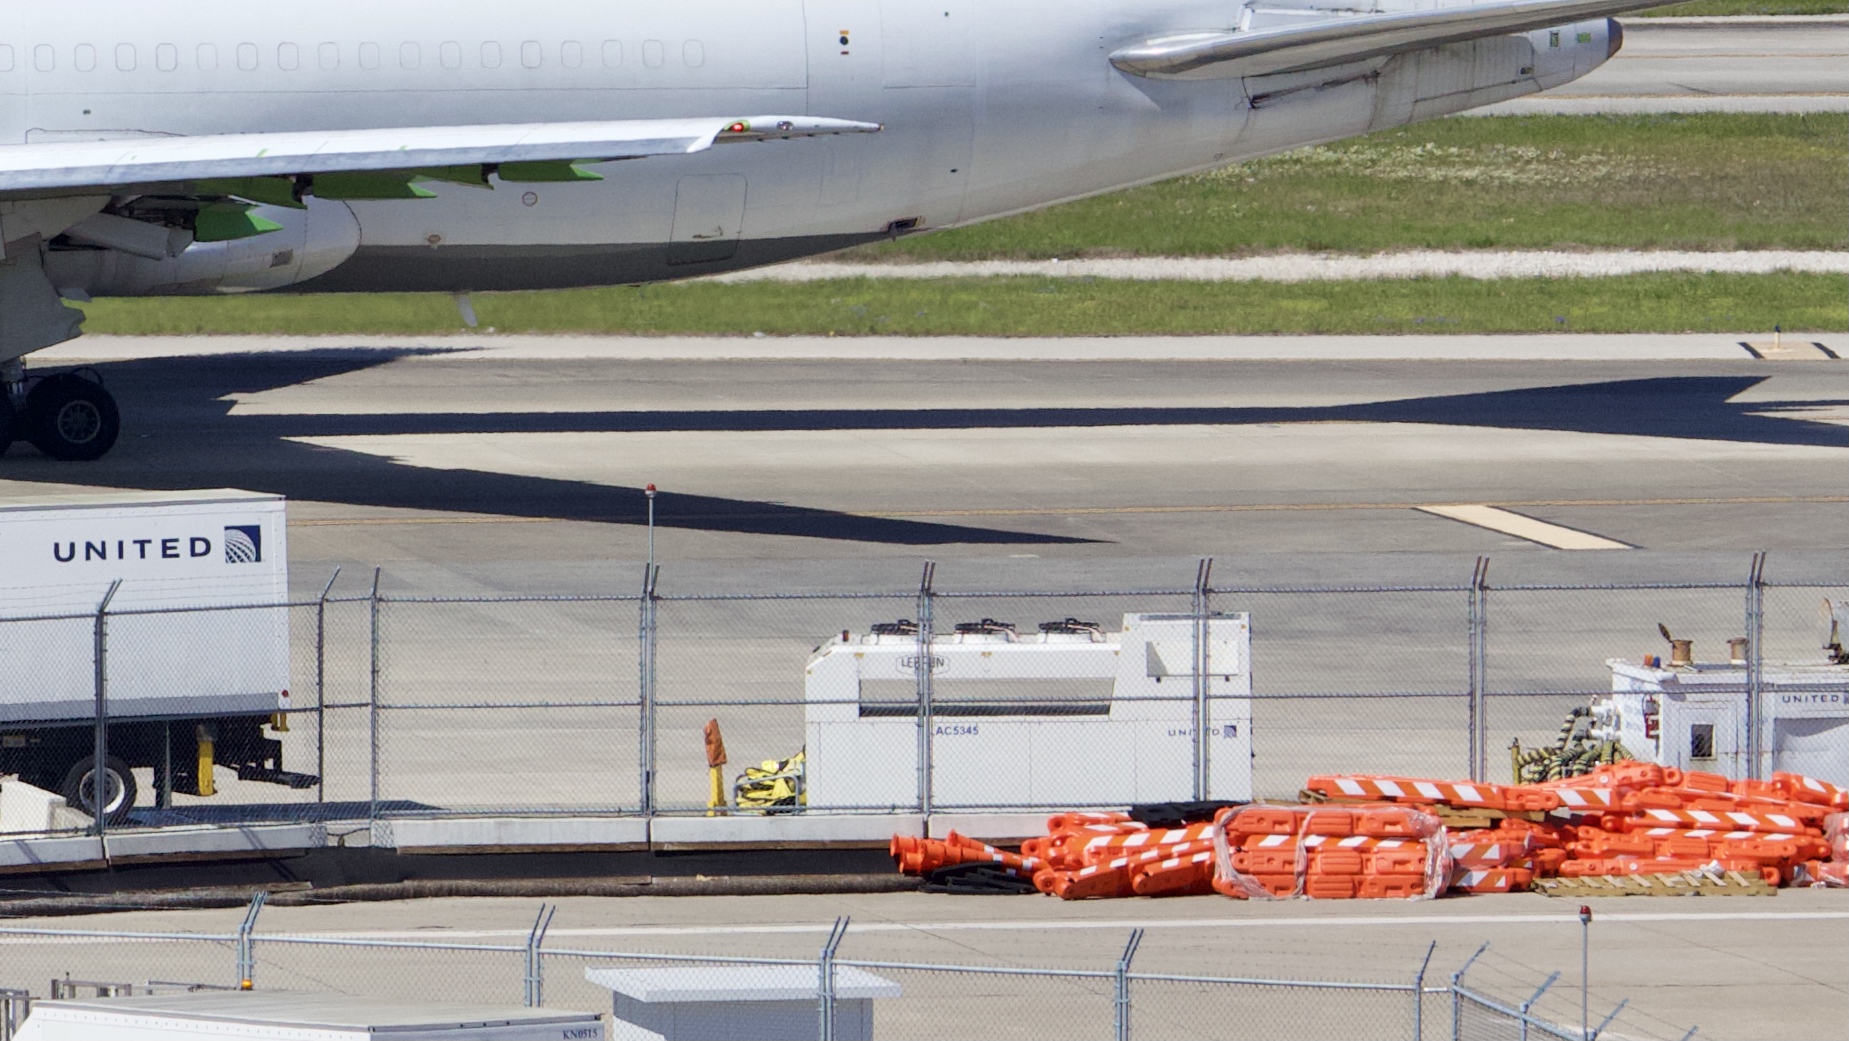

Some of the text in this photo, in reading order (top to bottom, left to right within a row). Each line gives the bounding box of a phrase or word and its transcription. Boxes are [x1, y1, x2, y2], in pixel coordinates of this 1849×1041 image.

[53, 536, 212, 563] UNITED
[1781, 694, 1839, 703] UNITED
[935, 725, 979, 736] AC5345
[1168, 728, 1220, 737] UNID
